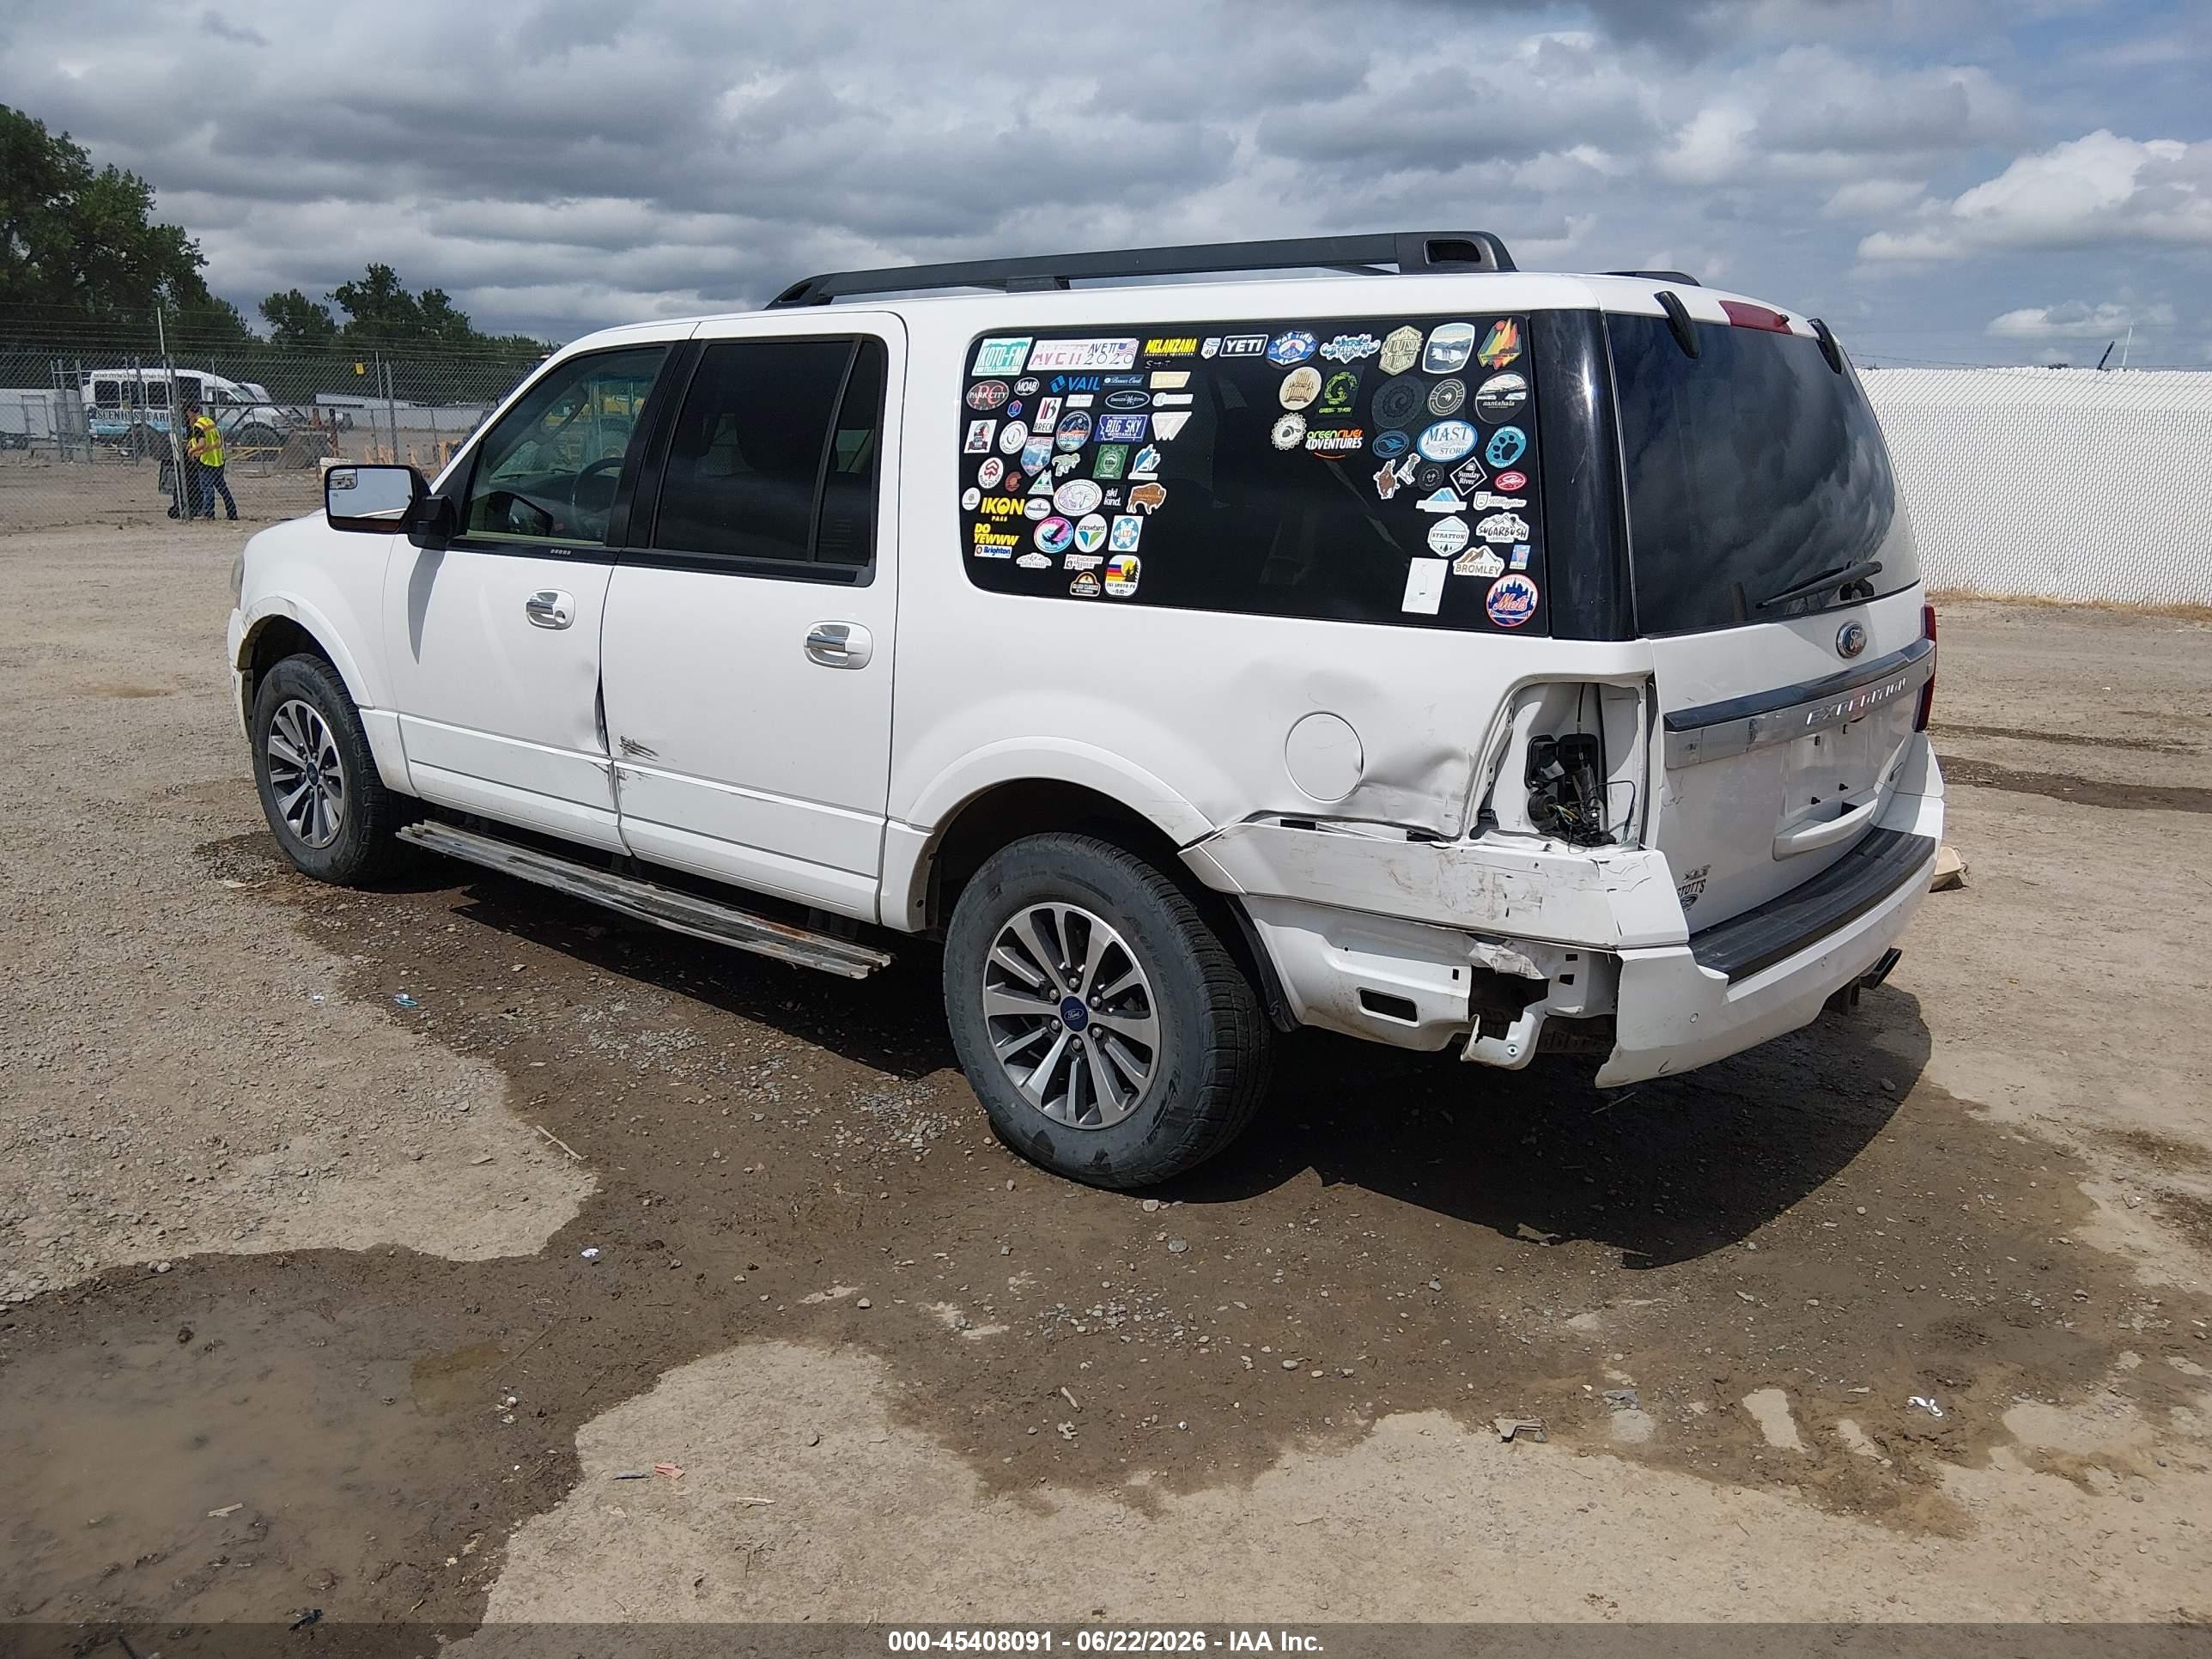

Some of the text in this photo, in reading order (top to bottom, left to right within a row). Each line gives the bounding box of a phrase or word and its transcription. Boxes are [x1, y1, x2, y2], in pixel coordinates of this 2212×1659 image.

[1145, 338, 1197, 354] MELANZANA
[1226, 339, 1263, 352] YETI
[1392, 337, 1424, 353] OUTSIDE
[978, 345, 1026, 367] KOTO-FM
[1085, 353, 1133, 365] 2020
[1017, 381, 1037, 392] MOAB
[1068, 376, 1100, 391] VAIL
[1034, 422, 1053, 432] BRECK
[1104, 419, 1142, 433] BIG SKY
[1425, 426, 1471, 445] MAST
[1305, 437, 1363, 450] ADVENTURES
[1440, 447, 1468, 455] STORE
[1457, 471, 1480, 480] Sunday
[1106, 488, 1118, 497] ski
[981, 497, 1025, 515] IKON
[1103, 497, 1121, 507] kind.
[975, 522, 991, 533] DO
[1478, 526, 1528, 538] SUGARBUSH
[974, 532, 1020, 546] YEWWW
[983, 546, 1011, 556] Brighton
[1455, 563, 1501, 575] BROMLEY
[1493, 592, 1528, 611] Mets
[1806, 677, 1906, 726] EXPEDITION
[1682, 864, 1711, 883] XLT
